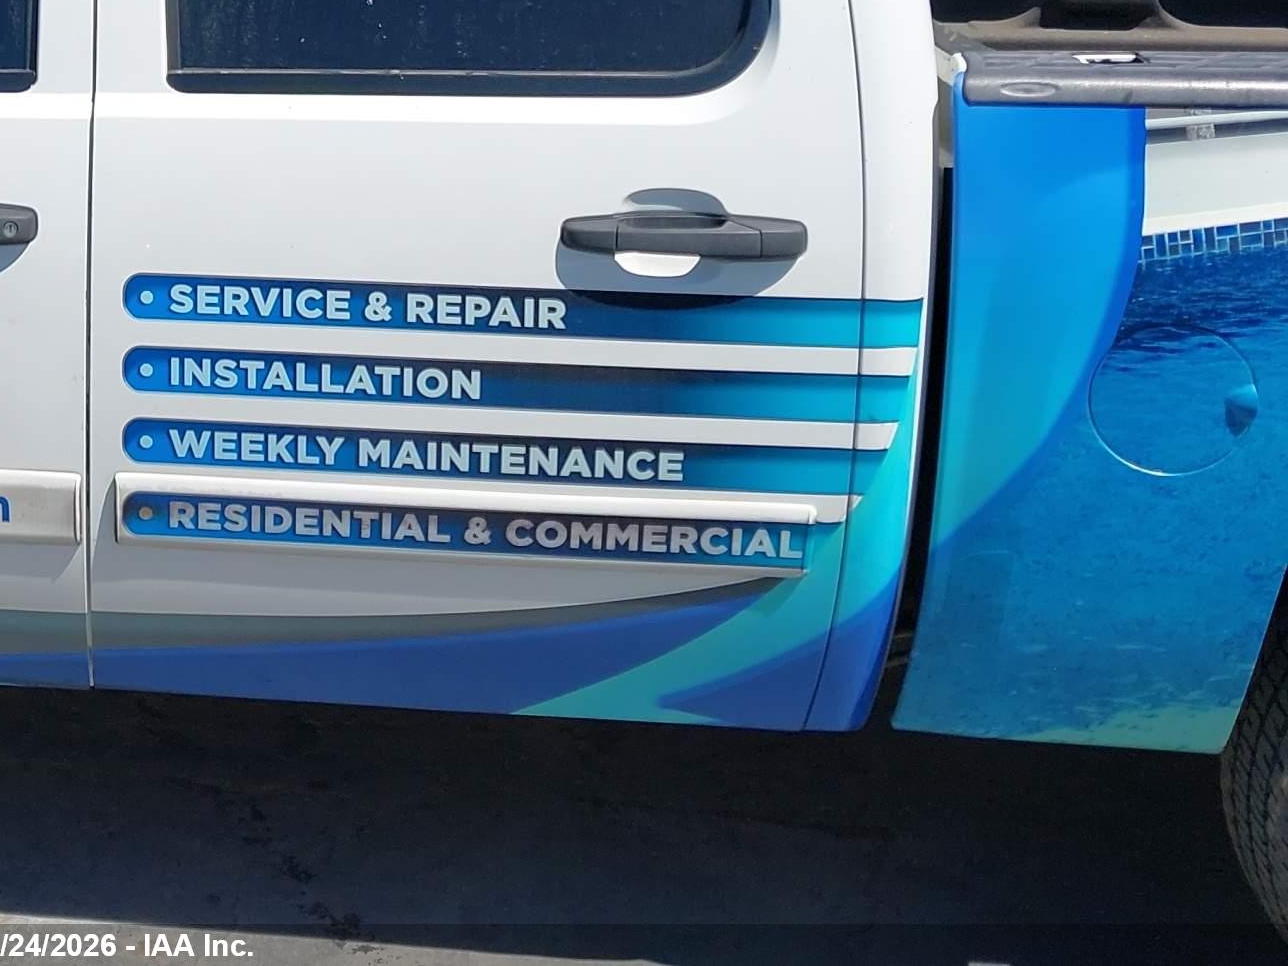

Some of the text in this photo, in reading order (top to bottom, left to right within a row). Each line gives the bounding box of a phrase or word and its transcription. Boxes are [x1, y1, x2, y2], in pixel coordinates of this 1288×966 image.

[169, 283, 567, 330] SERVICE & REPAIR
[169, 356, 482, 400] INSTALLATION
[168, 429, 684, 482] WEEKLY MAINTENANCE
[169, 501, 803, 560] RESIDENTIAL & COMMERCIAL
